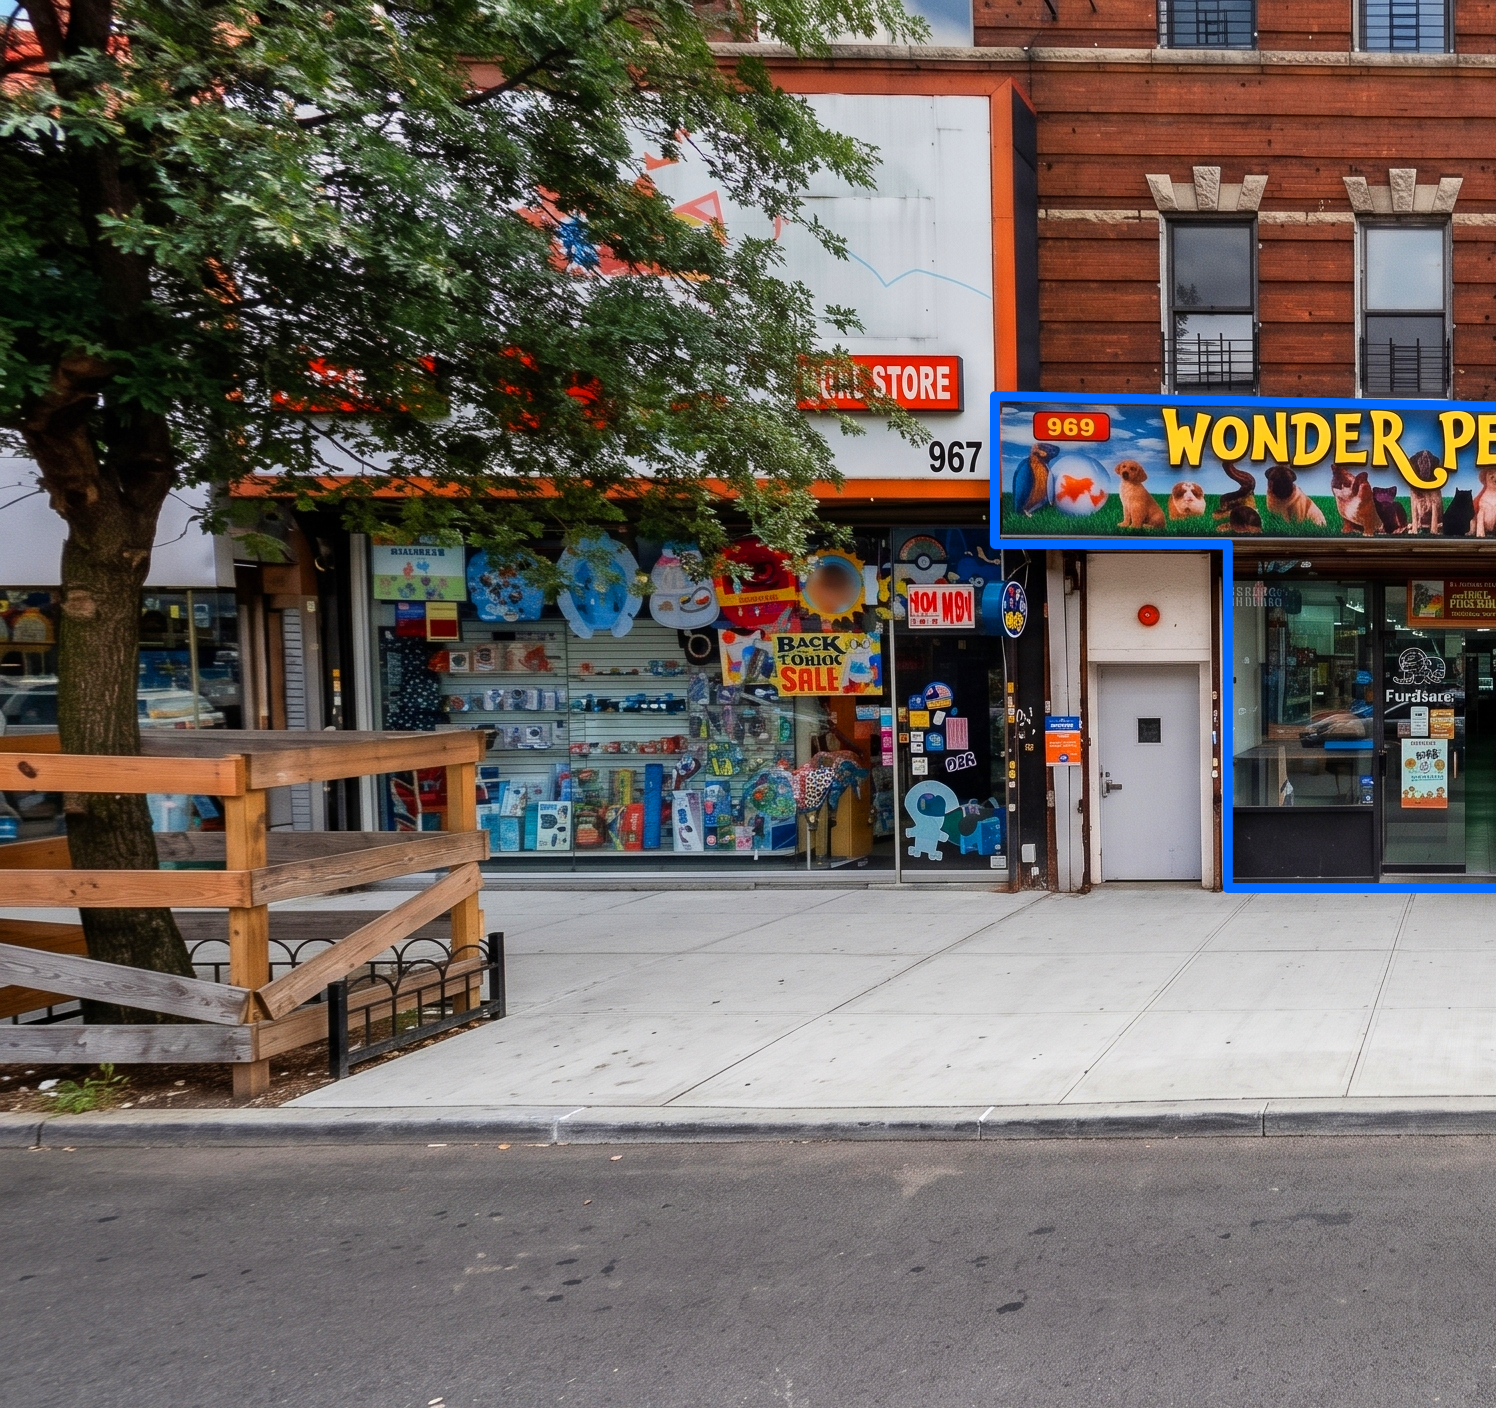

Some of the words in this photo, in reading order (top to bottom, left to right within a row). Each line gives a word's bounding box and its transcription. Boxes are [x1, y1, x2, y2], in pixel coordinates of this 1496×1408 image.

[872, 365, 951, 400] STORE
[1046, 417, 1096, 437] 969
[928, 440, 983, 474] 967
[1161, 407, 1449, 490] WONDER
[777, 636, 846, 654] BACK
[780, 666, 840, 692] SALE
